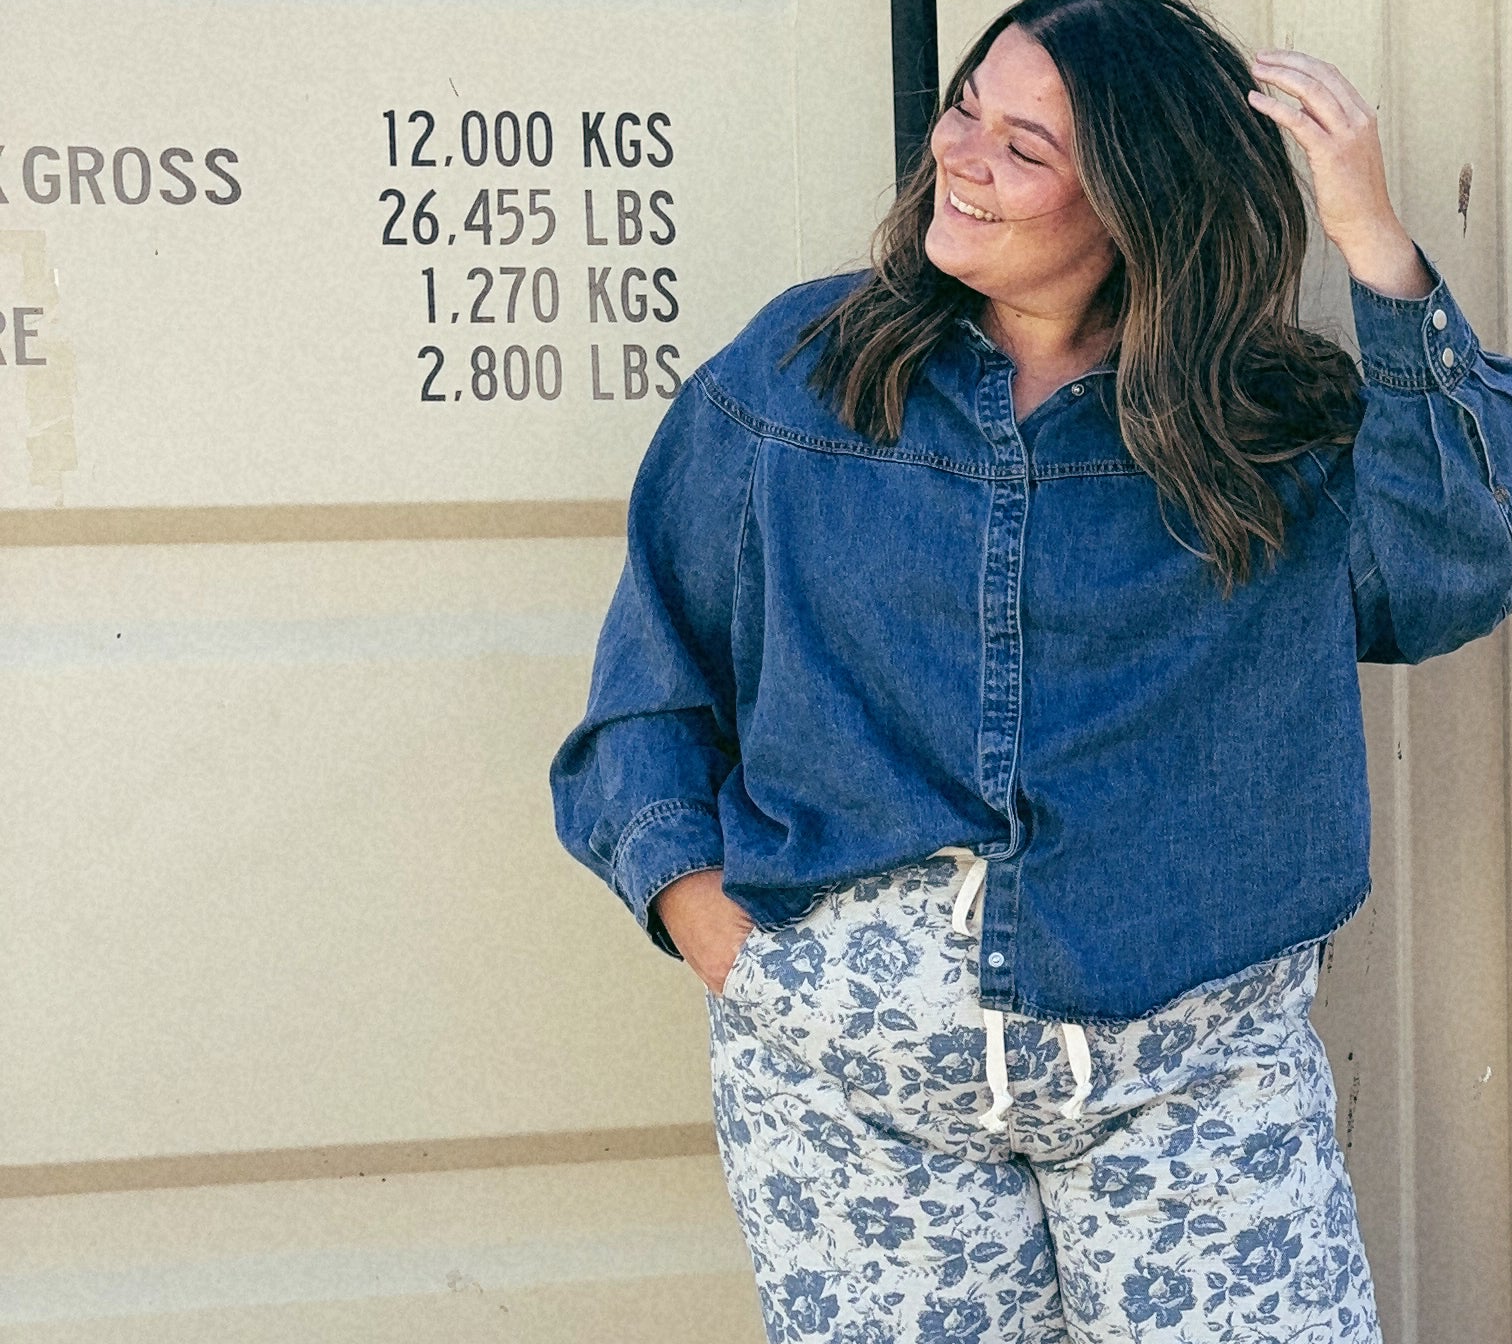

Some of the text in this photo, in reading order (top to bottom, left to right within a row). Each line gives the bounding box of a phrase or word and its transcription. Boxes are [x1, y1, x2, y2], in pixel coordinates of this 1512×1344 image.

[383, 110, 673, 168] 12,000 KGS
[23, 146, 241, 205] GROSS
[379, 188, 676, 246] 26,455 LBS
[422, 267, 679, 323] 1,270 KGS
[0, 307, 46, 365] E
[417, 344, 682, 402] 2,800 LBS
